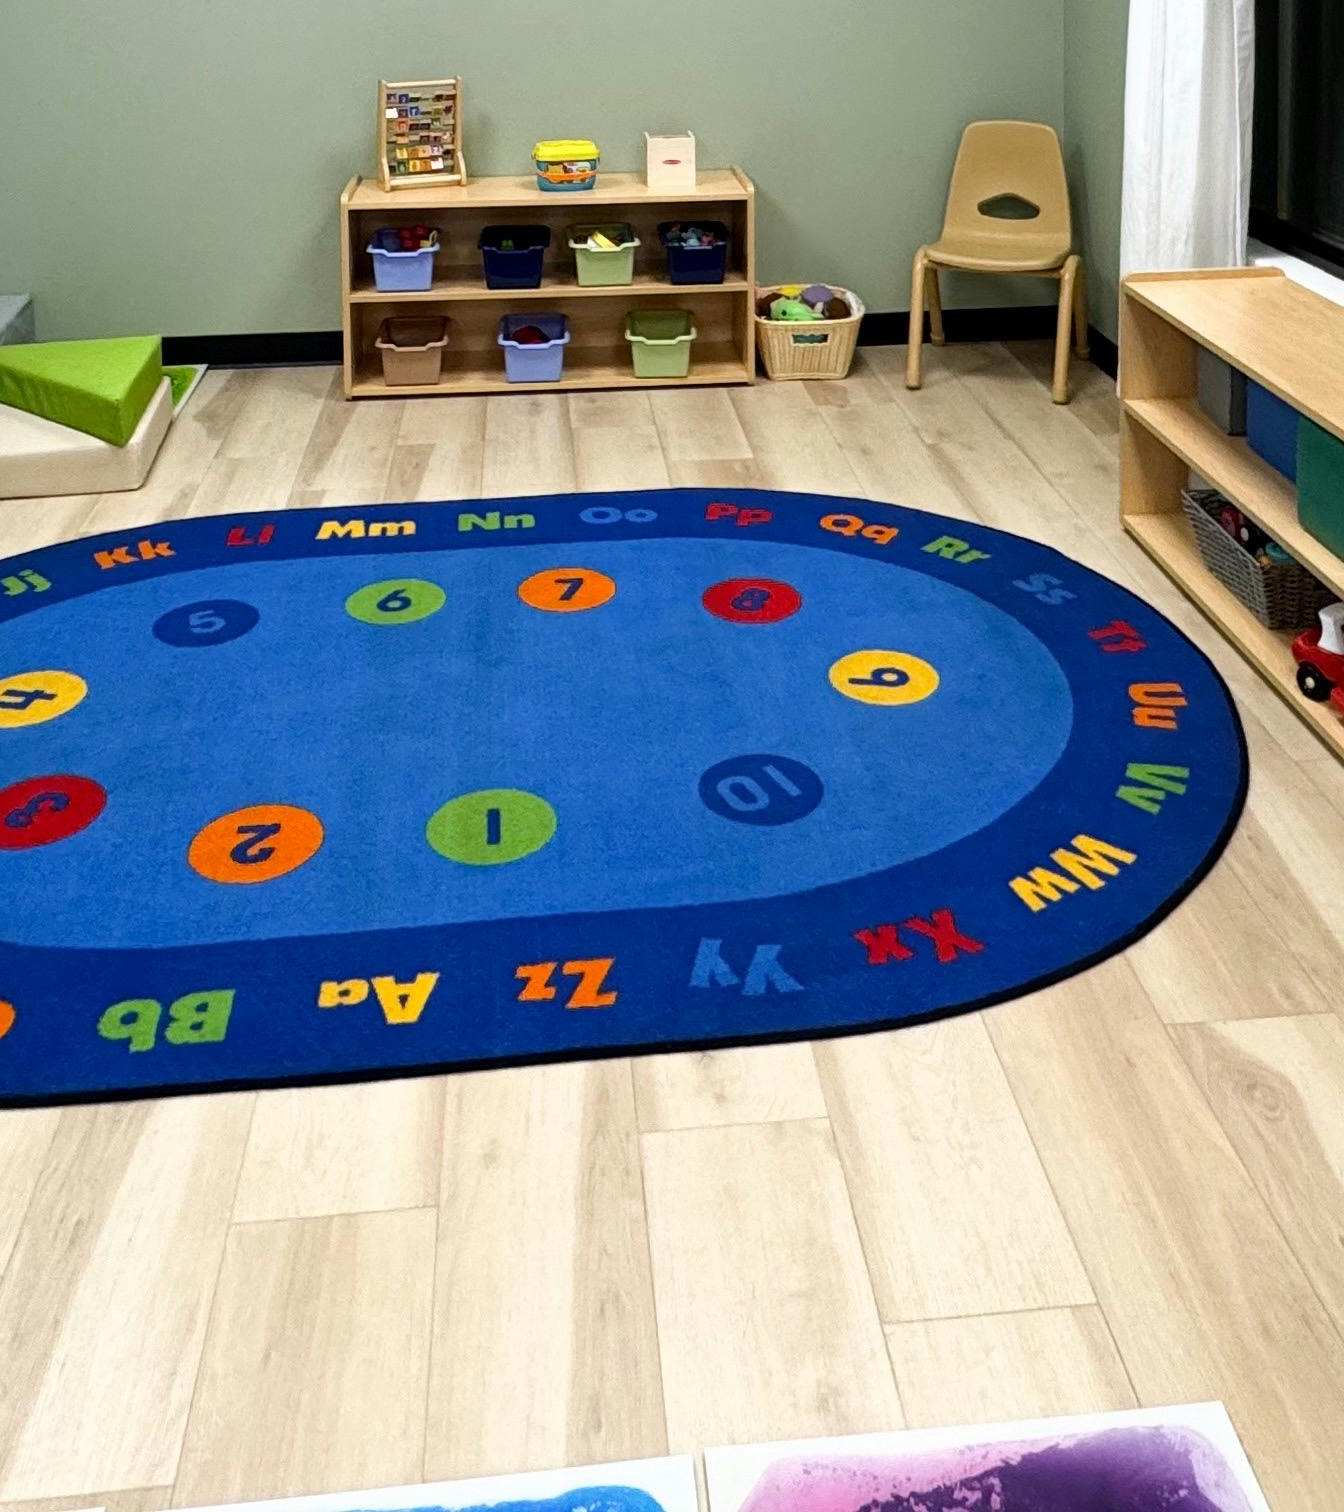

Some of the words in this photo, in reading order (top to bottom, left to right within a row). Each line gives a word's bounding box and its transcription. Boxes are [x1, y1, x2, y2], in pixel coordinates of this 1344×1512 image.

[315, 520, 416, 540] Mm
[458, 510, 535, 531] Nn
[580, 507, 657, 523] Oo
[705, 503, 772, 526] Pp
[820, 514, 899, 544] Qq
[93, 539, 176, 570] Kk
[921, 536, 991, 564] Rr
[2, 569, 52, 596] Jj
[553, 577, 585, 601] 7
[376, 589, 412, 612] 6
[731, 588, 771, 612] 8
[189, 609, 226, 633] 5
[848, 667, 911, 687] 9
[1128, 682, 1188, 730] Uu
[716, 763, 803, 813] 10
[1116, 763, 1189, 815] Vv
[4, 791, 71, 829] 3
[485, 808, 501, 845] 1
[230, 823, 282, 865] 2
[1008, 834, 1137, 912] Ww
[854, 909, 984, 964] Xx
[690, 938, 804, 995] Yy
[318, 972, 440, 1025] Aa
[515, 957, 618, 1009] Zz
[97, 989, 236, 1053] Bb
